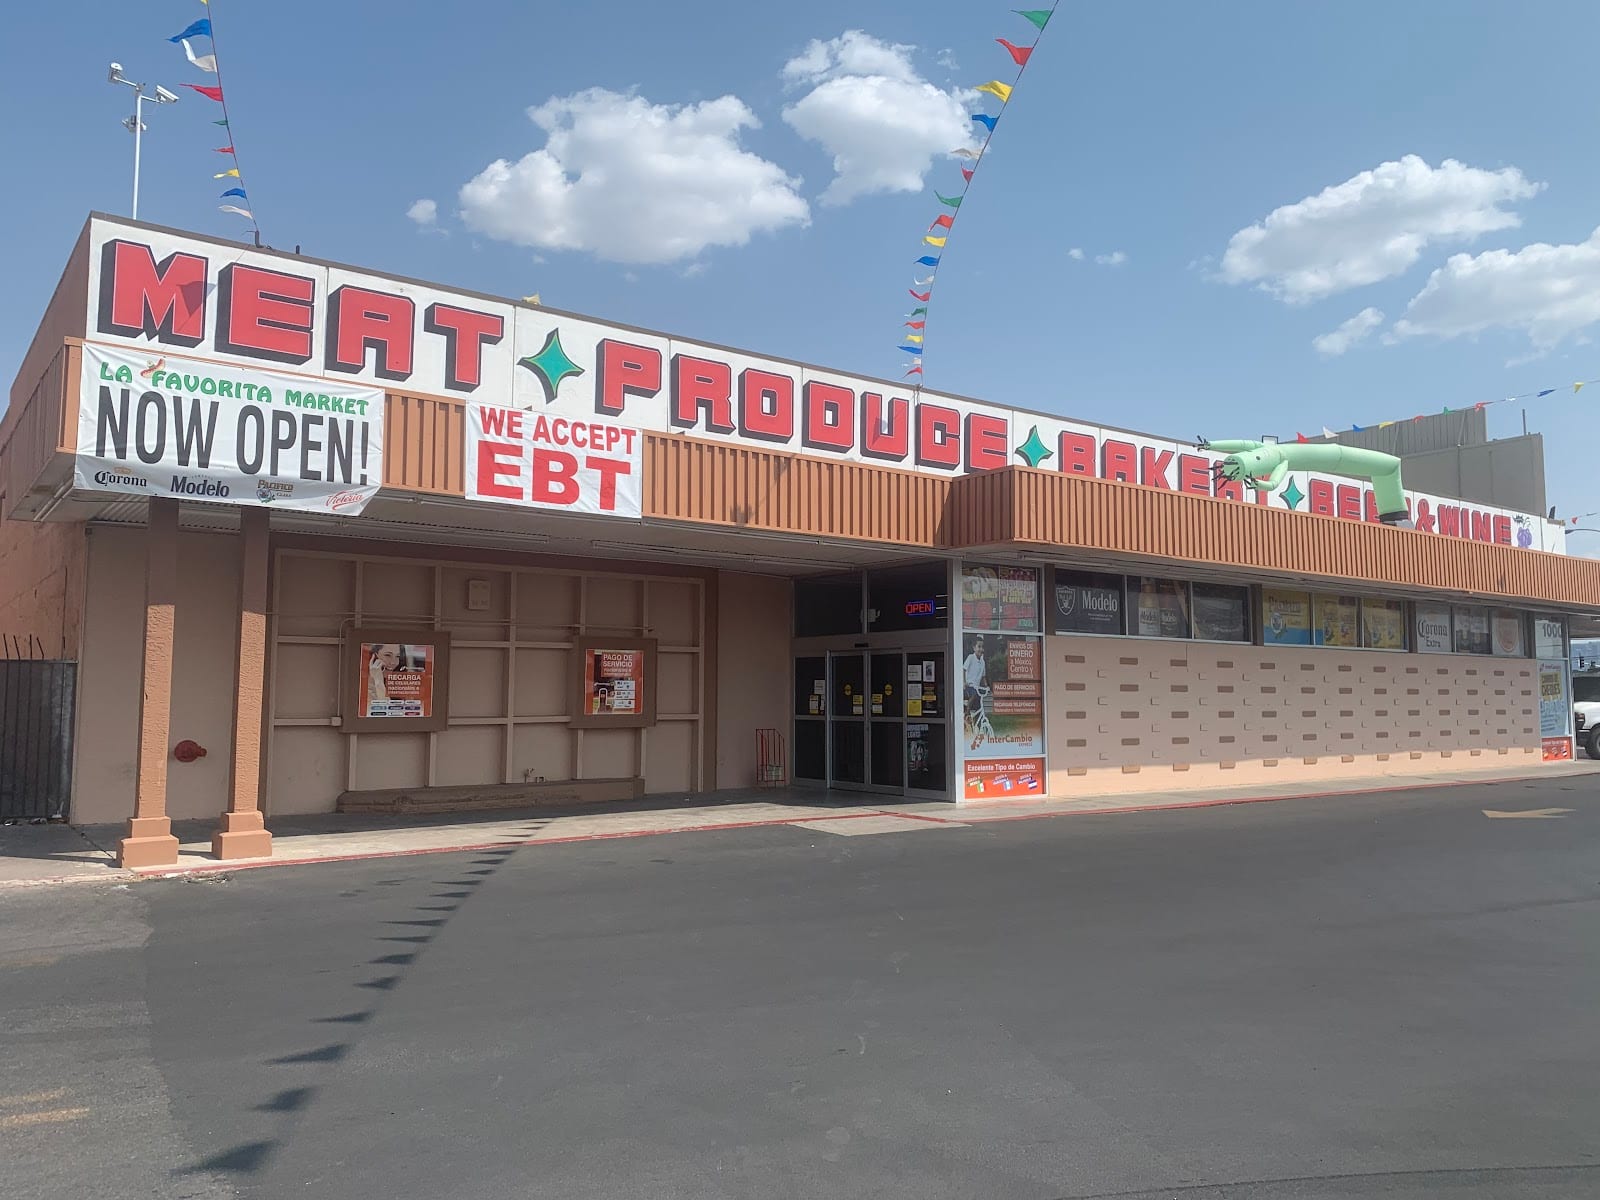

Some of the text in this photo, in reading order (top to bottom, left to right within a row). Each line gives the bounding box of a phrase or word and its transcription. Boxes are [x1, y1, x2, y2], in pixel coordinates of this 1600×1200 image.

[97, 239, 505, 392] MEAT
[100, 362, 369, 416] LA FAVORITA MARKET
[595, 338, 1008, 472] PRODUCE
[98, 385, 370, 486] NOW OPEN!
[479, 406, 637, 455] WE ACCEPT
[94, 470, 147, 488] Corona
[170, 475, 230, 498] Modelo
[477, 441, 631, 511] EBT
[1309, 478, 1411, 526] BEE
[1437, 503, 1512, 546] WINE
[905, 603, 932, 614] OPEN
[1082, 590, 1118, 612] Modelo
[1417, 619, 1448, 638] Corona
[1425, 636, 1441, 648] Extra
[602, 660, 633, 668] SERVICIO
[603, 653, 622, 661] PAGO
[987, 733, 1033, 744] InterCambio
[995, 763, 1007, 773] Tipo
[1015, 762, 1036, 771] Cambio
